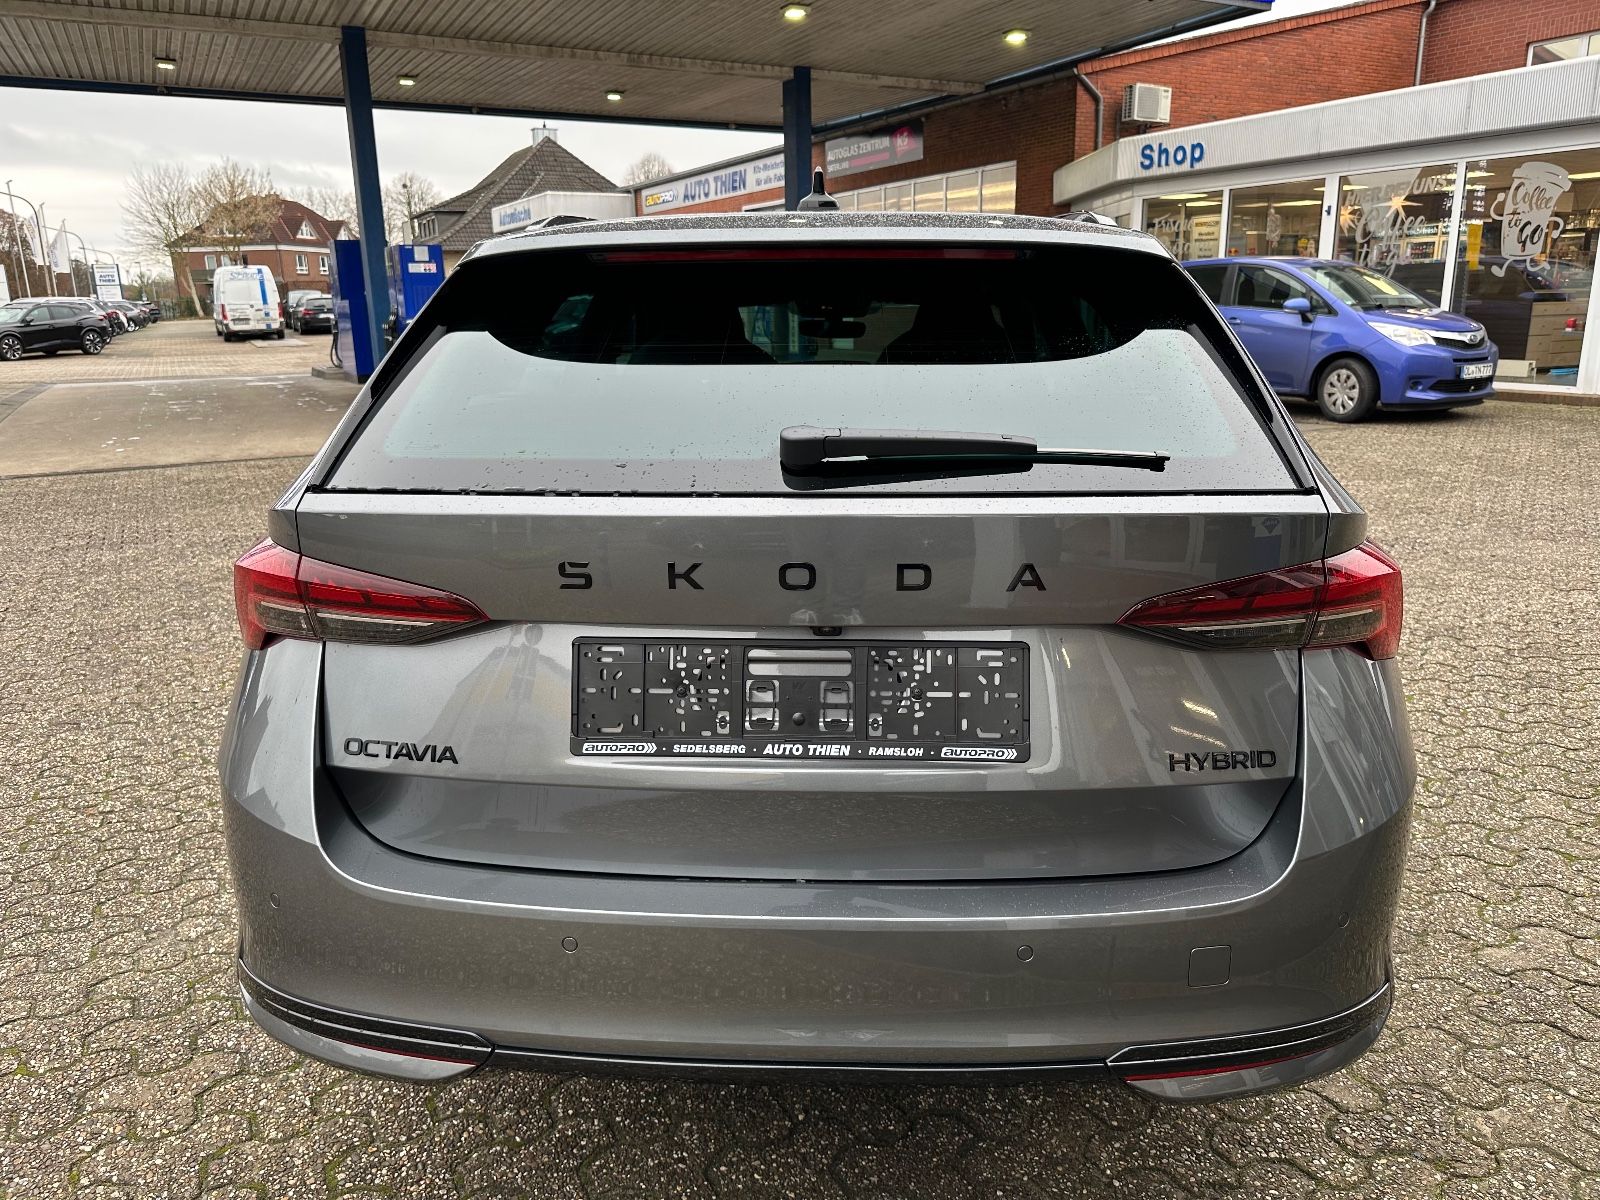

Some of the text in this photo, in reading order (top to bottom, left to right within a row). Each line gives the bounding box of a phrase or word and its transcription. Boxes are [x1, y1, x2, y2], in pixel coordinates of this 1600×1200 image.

[860, 136, 890, 154] ZENTRUM
[1140, 142, 1204, 170] Shop
[683, 178, 710, 203] AUTO
[713, 169, 747, 196] THIEN
[1412, 177, 1447, 195] UNS
[1512, 181, 1554, 212] Coffee
[1505, 208, 1522, 229] to
[558, 561, 1047, 592] SKODA
[343, 737, 459, 765] OCTAVIA
[672, 744, 747, 754] SEDELSBERG
[763, 743, 803, 756] AUTO
[807, 744, 851, 756] THIEN
[868, 746, 924, 757] RAMSLOH
[1168, 750, 1276, 772] HYBRID
